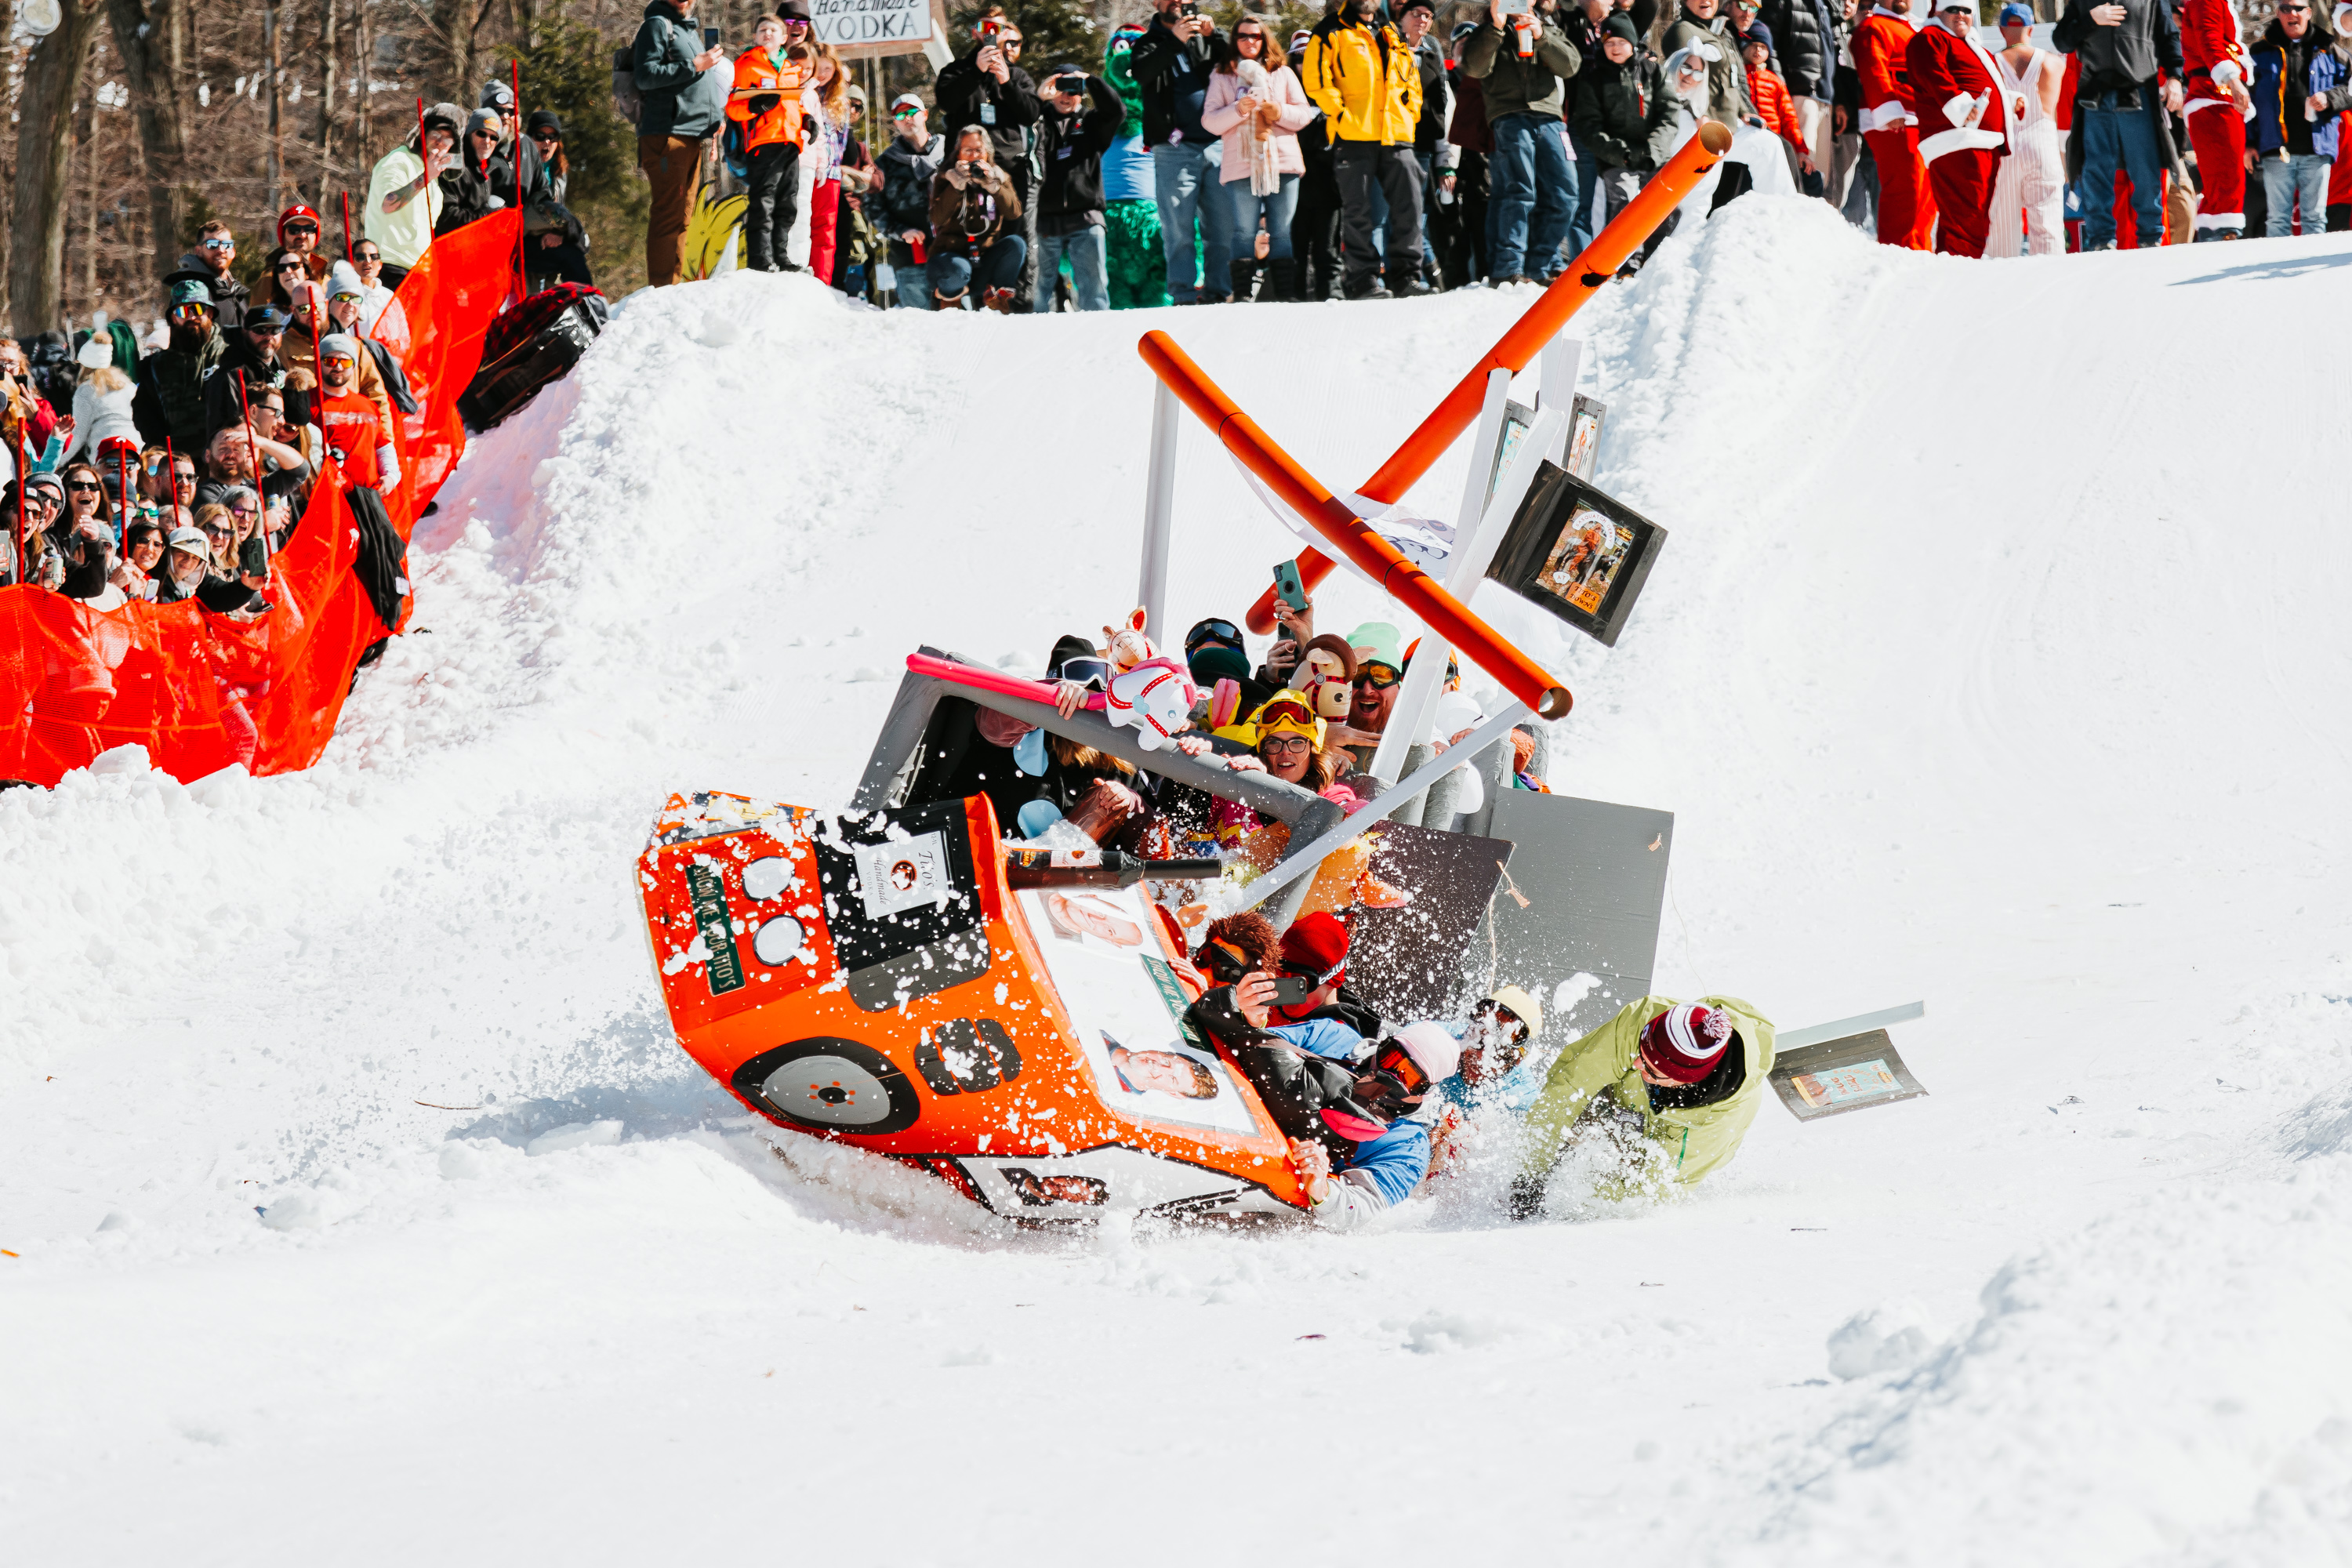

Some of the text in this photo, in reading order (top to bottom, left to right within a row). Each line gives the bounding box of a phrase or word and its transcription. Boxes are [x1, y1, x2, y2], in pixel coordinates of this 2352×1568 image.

[810, 12, 918, 41] VODKA
[1576, 514, 1606, 527] SASQUATCH
[1570, 593, 1593, 609] DOWNS
[1574, 586, 1597, 601] TITO'S
[694, 865, 717, 897] SHOW
[873, 857, 891, 905] Handmade
[702, 898, 720, 919] ME
[713, 952, 736, 989] TITO'S
[1147, 957, 1205, 1049] SHOW ME YOUR TITO'S
